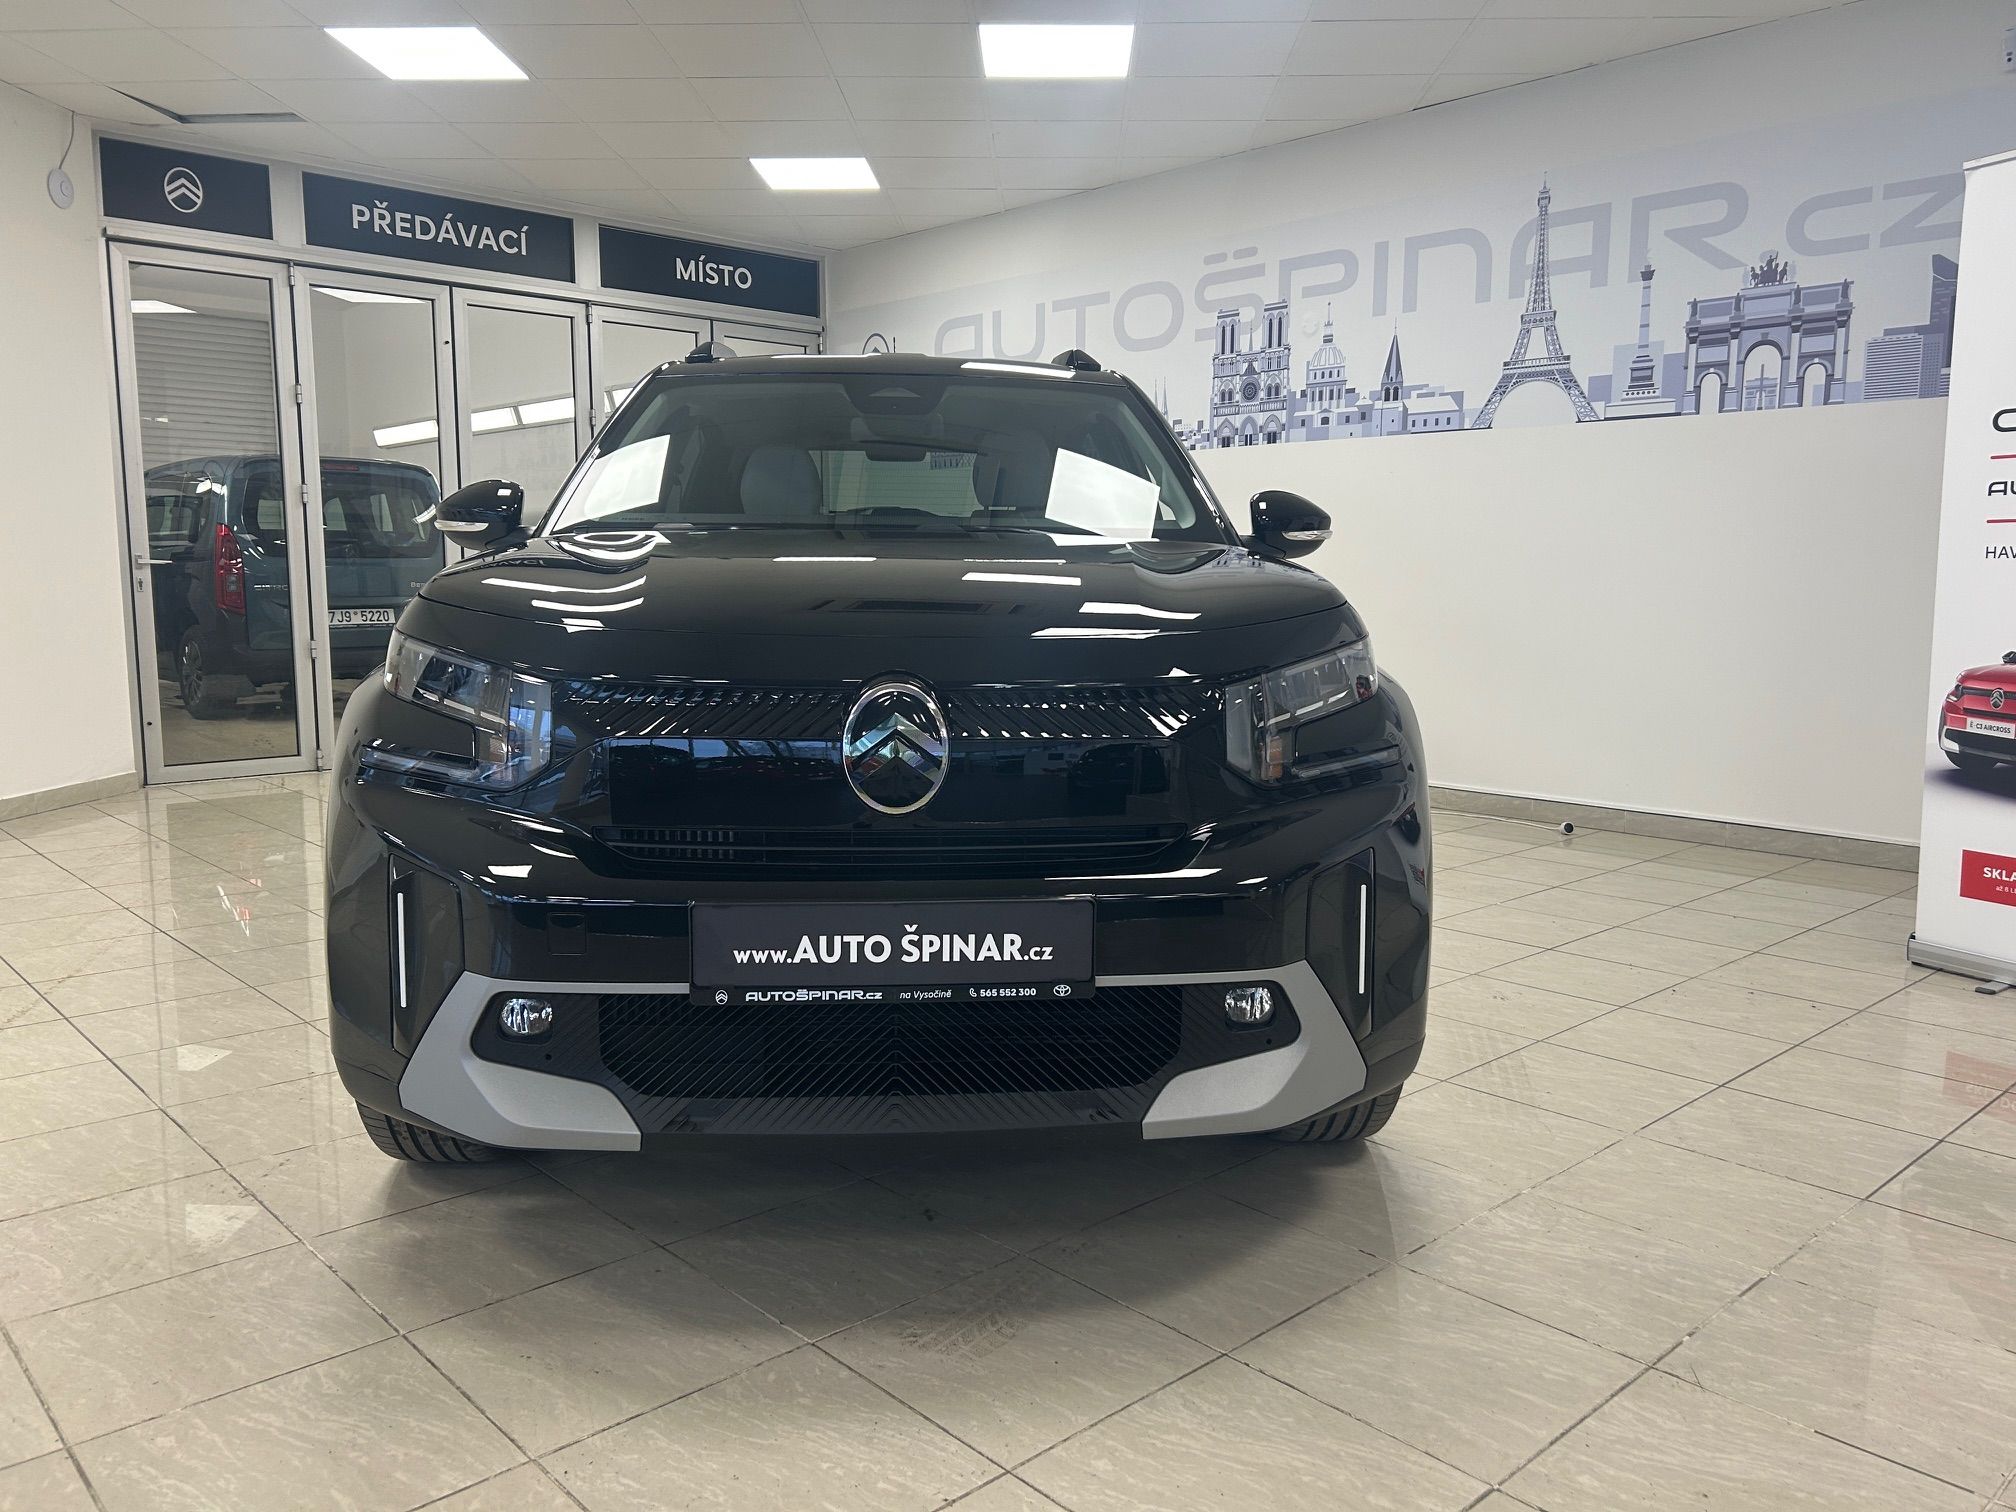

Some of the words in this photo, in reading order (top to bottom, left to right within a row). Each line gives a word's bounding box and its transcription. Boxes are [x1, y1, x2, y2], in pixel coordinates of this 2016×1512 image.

[352, 200, 529, 256] PŘEDÁVACÍ
[675, 255, 753, 290] MÍSTO
[328, 611, 352, 623] 7J9
[360, 610, 390, 622] 5220
[733, 934, 892, 964] www.AUTO
[900, 924, 1054, 962] ŠPINAR.cz
[745, 988, 883, 1002] AUTOŠPINAR.cz
[913, 989, 952, 1000] Vysočině
[979, 988, 998, 997] 565
[999, 988, 1016, 997] 552
[1018, 987, 1037, 996] 300
